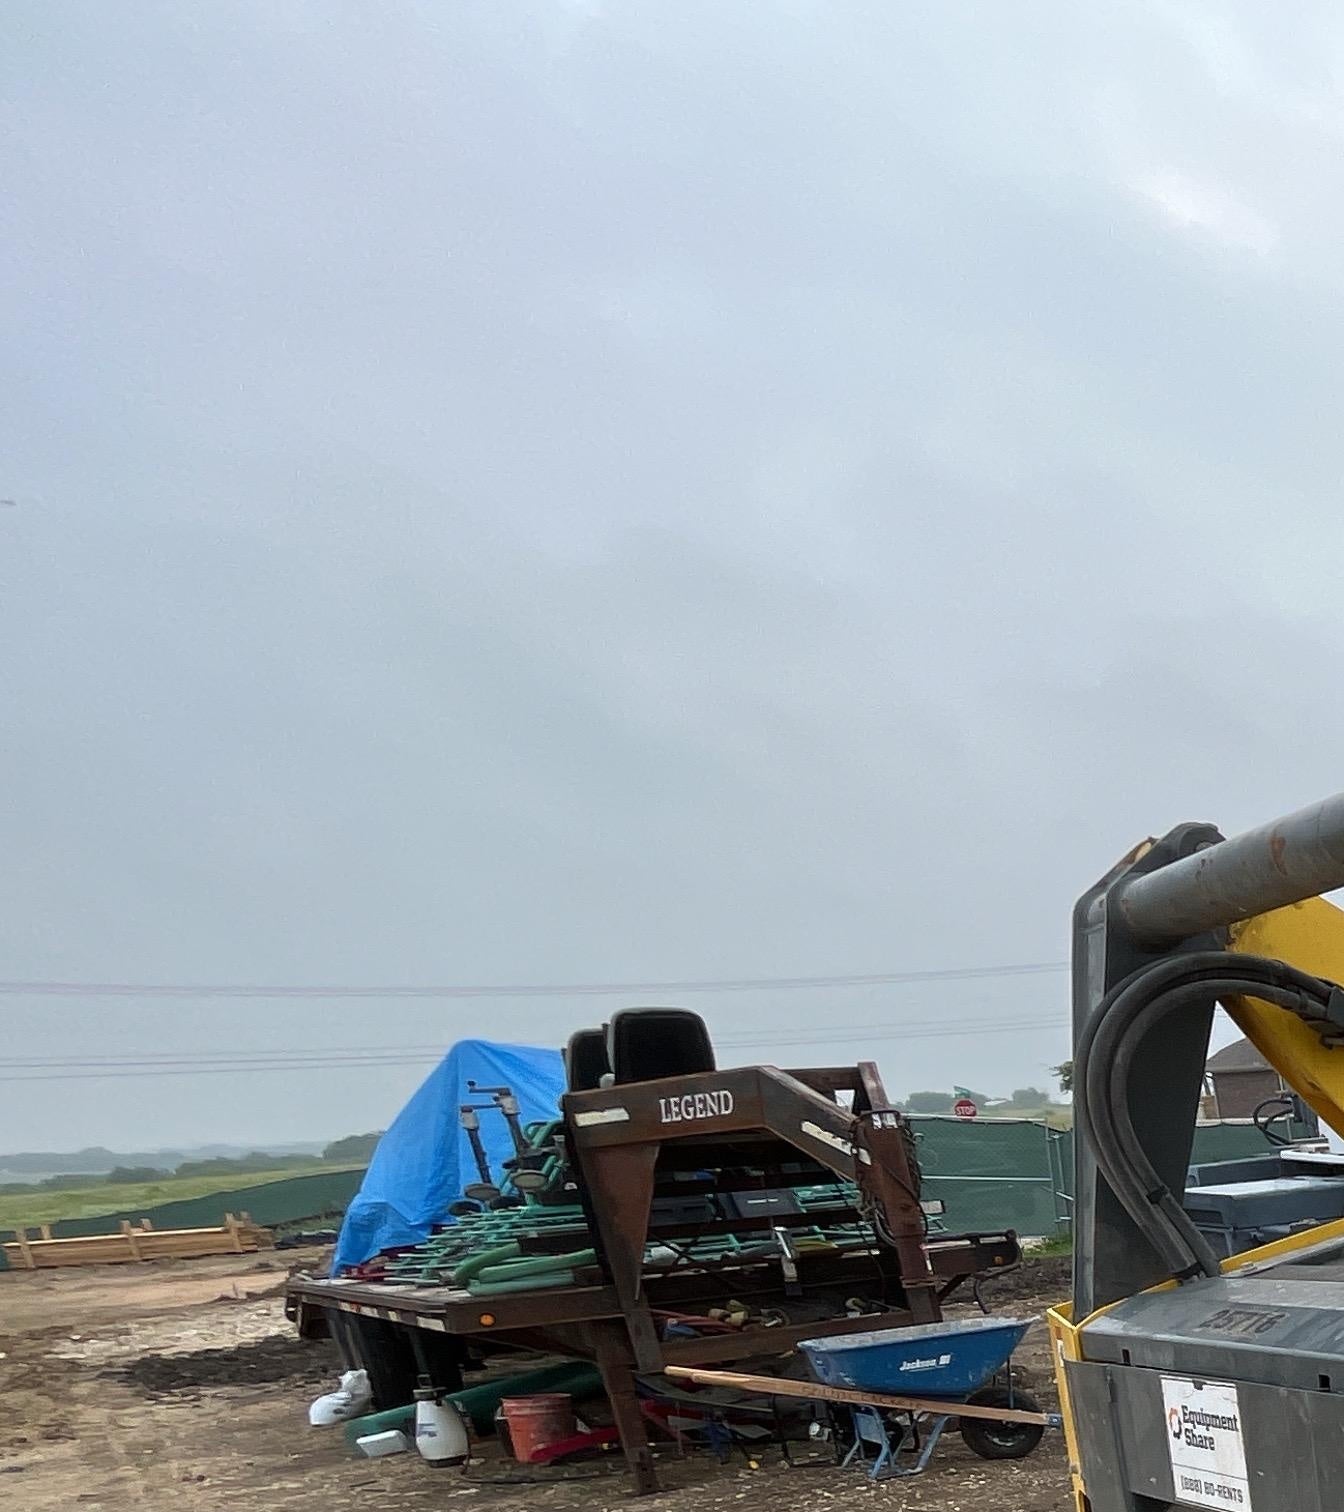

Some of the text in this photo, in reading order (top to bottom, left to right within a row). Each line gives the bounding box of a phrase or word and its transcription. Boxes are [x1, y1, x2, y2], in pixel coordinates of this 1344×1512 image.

[659, 1090, 733, 1123] LEGEND
[956, 1105, 976, 1116] STOP
[1181, 1405, 1239, 1432] Equipment
[1184, 1427, 1216, 1451] Share
